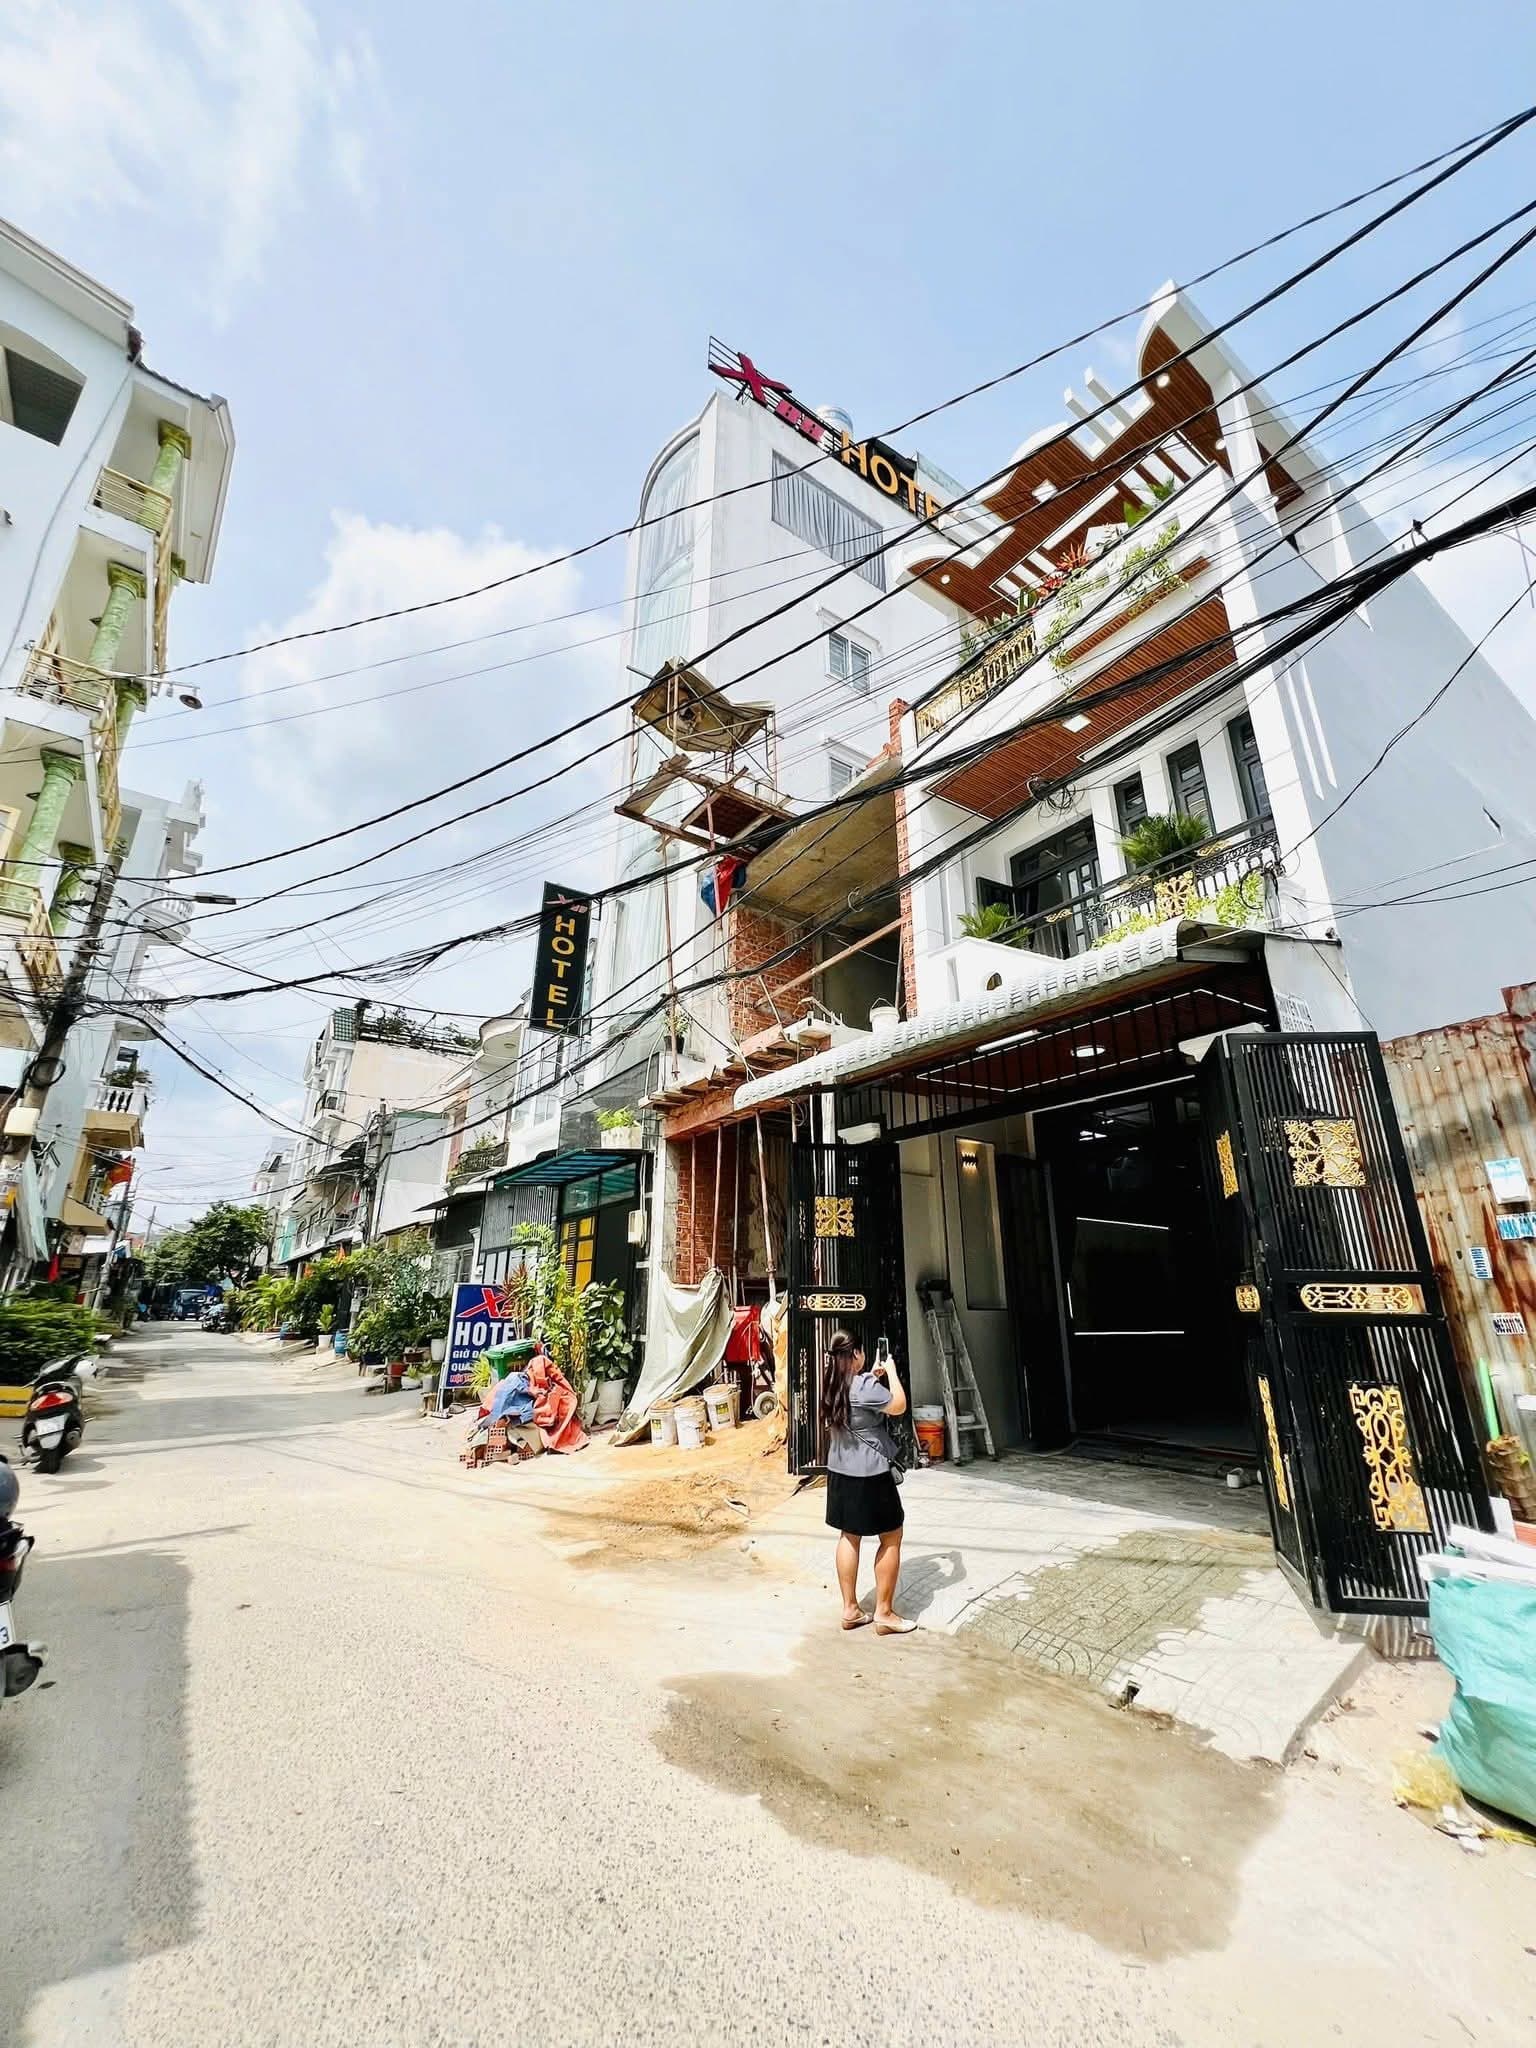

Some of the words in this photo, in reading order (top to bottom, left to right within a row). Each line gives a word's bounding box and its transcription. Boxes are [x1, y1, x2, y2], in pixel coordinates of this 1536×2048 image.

[841, 430, 946, 528] HOTE
[546, 914, 576, 1029] HOTEL
[454, 1321, 517, 1346] HOTE
